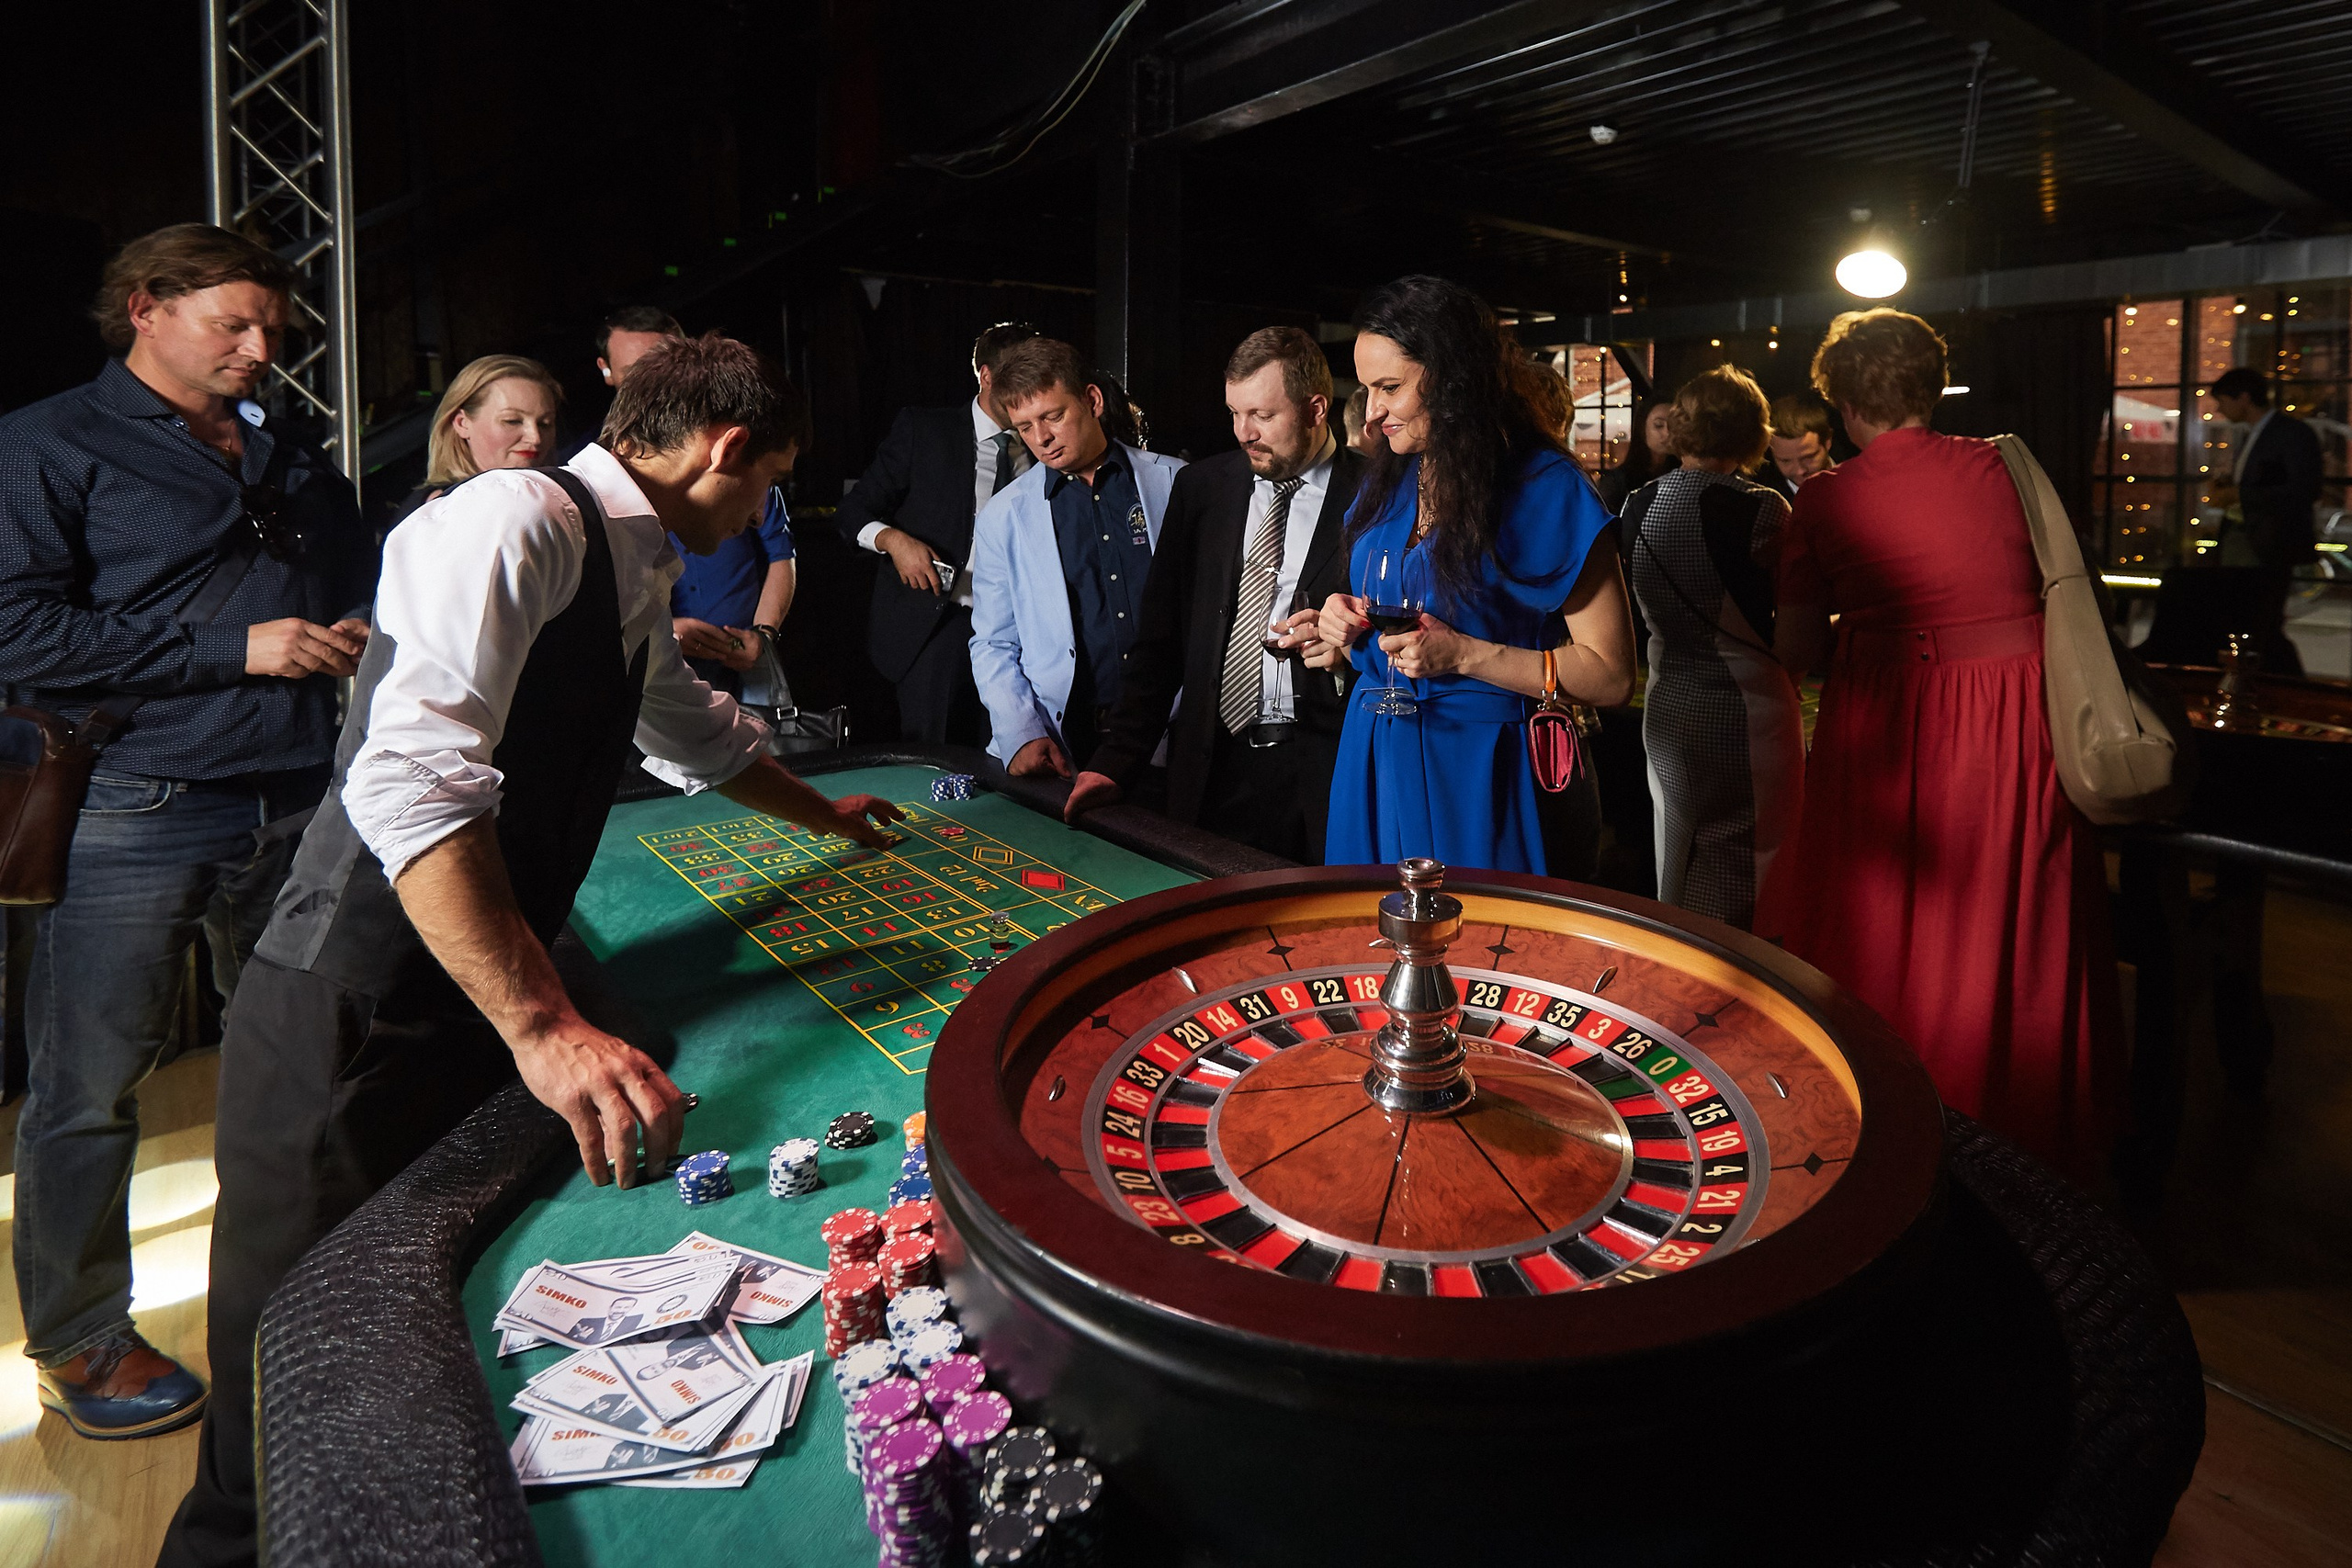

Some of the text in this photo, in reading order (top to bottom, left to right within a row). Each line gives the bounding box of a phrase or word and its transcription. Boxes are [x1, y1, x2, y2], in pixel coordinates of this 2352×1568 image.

[698, 865, 735, 877] 30
[859, 865, 896, 878] 22
[818, 891, 856, 905] 20
[842, 907, 874, 921] 17
[926, 906, 962, 919] 13
[953, 922, 989, 938] 10
[790, 939, 831, 955] 15
[890, 940, 924, 954] 11
[1281, 987, 1299, 1010] 9
[1313, 979, 1344, 1003] 22
[1353, 976, 1380, 1000] 18
[1471, 983, 1502, 1008] 28
[1239, 993, 1270, 1020] 31
[1513, 991, 1541, 1017] 12
[1206, 1006, 1238, 1032] 14
[1546, 1001, 1582, 1029] 35
[902, 1022, 931, 1039] 3
[1173, 1021, 1210, 1049] 20
[1588, 1019, 1611, 1040] 3
[1154, 1043, 1182, 1062] 1
[1612, 1032, 1652, 1059] 26
[1126, 1060, 1165, 1088] 33
[1649, 1056, 1678, 1076] 0
[1114, 1086, 1148, 1110] 16
[1671, 1076, 1710, 1103] 32
[1105, 1111, 1141, 1138] 24
[1688, 1102, 1727, 1126] 15
[1701, 1130, 1740, 1152] 19
[1106, 1145, 1142, 1160] 5
[1114, 1171, 1155, 1190] 10
[1704, 1165, 1744, 1178] 4
[1697, 1190, 1741, 1210] 21
[1137, 1200, 1181, 1223] 23
[1680, 1223, 1723, 1235] 2
[1170, 1234, 1205, 1246] 8
[1649, 1244, 1701, 1267] 25
[535, 1284, 588, 1310] SIMKO
[750, 1291, 794, 1308] SIMKO
[572, 1365, 618, 1386] SIMKO
[671, 1379, 701, 1405] SIMKO
[551, 1428, 603, 1441] SIM
